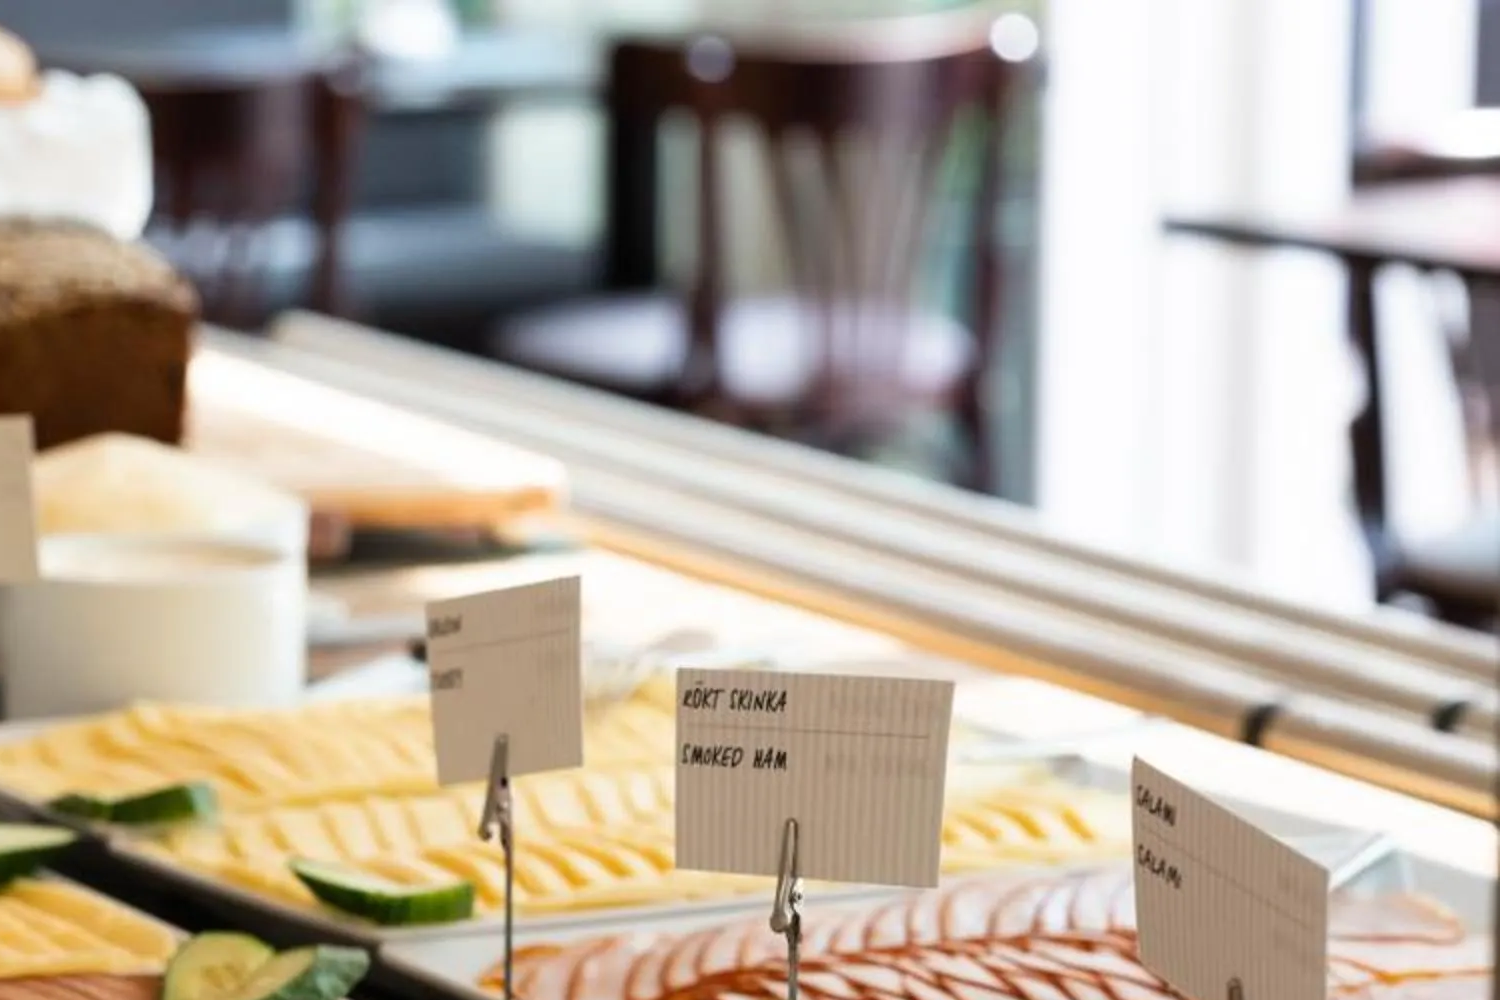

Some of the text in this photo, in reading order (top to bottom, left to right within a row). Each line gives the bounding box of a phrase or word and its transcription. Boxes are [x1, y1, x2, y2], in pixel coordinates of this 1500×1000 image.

[729, 688, 787, 713] SKINKA
[681, 742, 788, 770] SMOKED HAM
